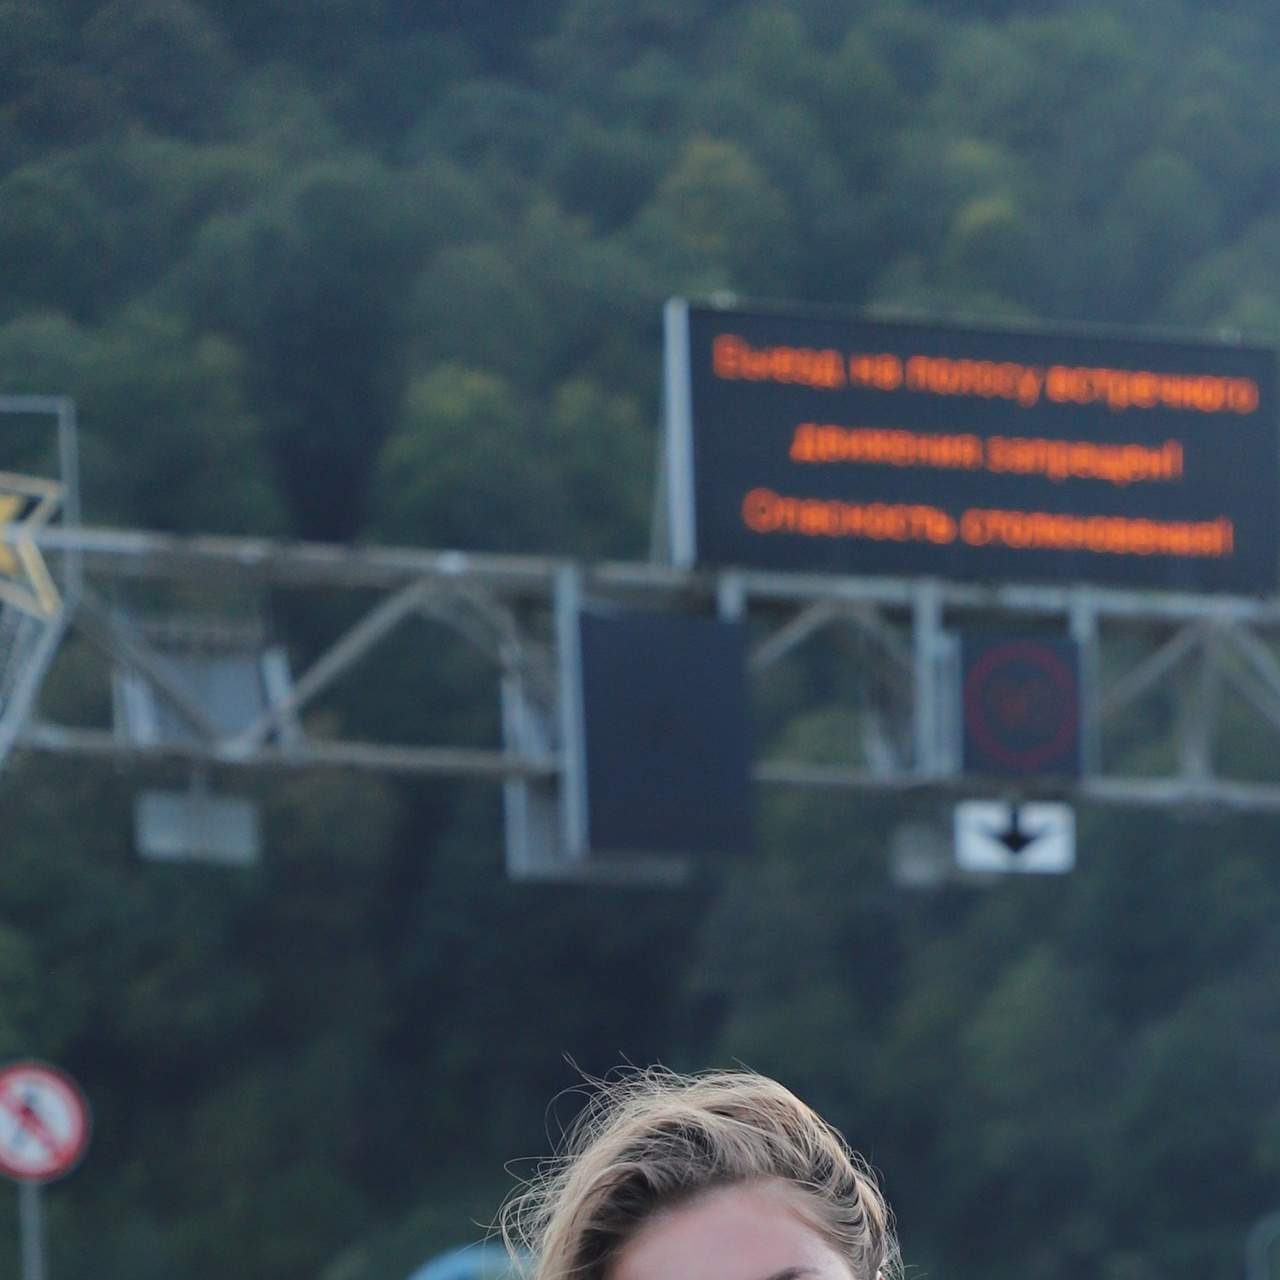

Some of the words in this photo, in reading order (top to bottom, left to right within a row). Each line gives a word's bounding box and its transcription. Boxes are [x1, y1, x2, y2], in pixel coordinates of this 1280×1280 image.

[714, 334, 845, 389] Выезд
[850, 354, 902, 390] на
[906, 355, 1041, 407] полосу
[1046, 365, 1258, 414] встречного
[743, 487, 957, 544] Опасность
